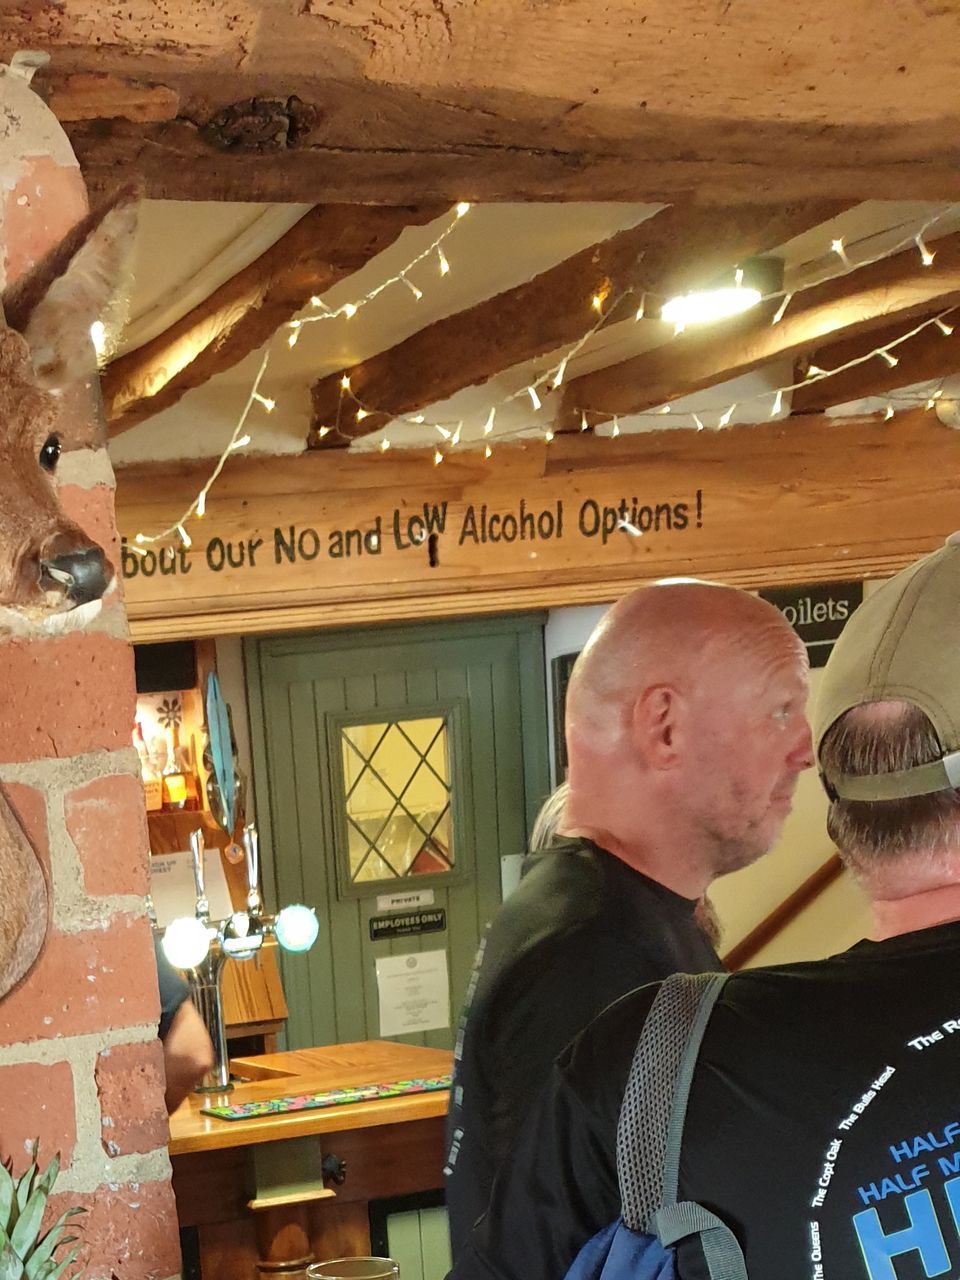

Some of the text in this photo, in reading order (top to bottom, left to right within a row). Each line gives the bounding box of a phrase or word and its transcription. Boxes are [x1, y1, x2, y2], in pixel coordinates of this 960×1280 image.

[121, 536, 192, 579] bout
[206, 536, 263, 572] Our
[274, 525, 321, 564] NO
[328, 516, 382, 558] and
[458, 499, 563, 546] Alcohol
[782, 597, 849, 625] oilets
[373, 912, 443, 929] EMPLOYEES ONLY
[906, 1019, 960, 1051] The R
[838, 1065, 896, 1131] The Bulls Head
[889, 1121, 960, 1163] HALF
[811, 1138, 843, 1209] The Copt Oak
[858, 1163, 931, 1205] HALF
[810, 1220, 823, 1262] Queens
